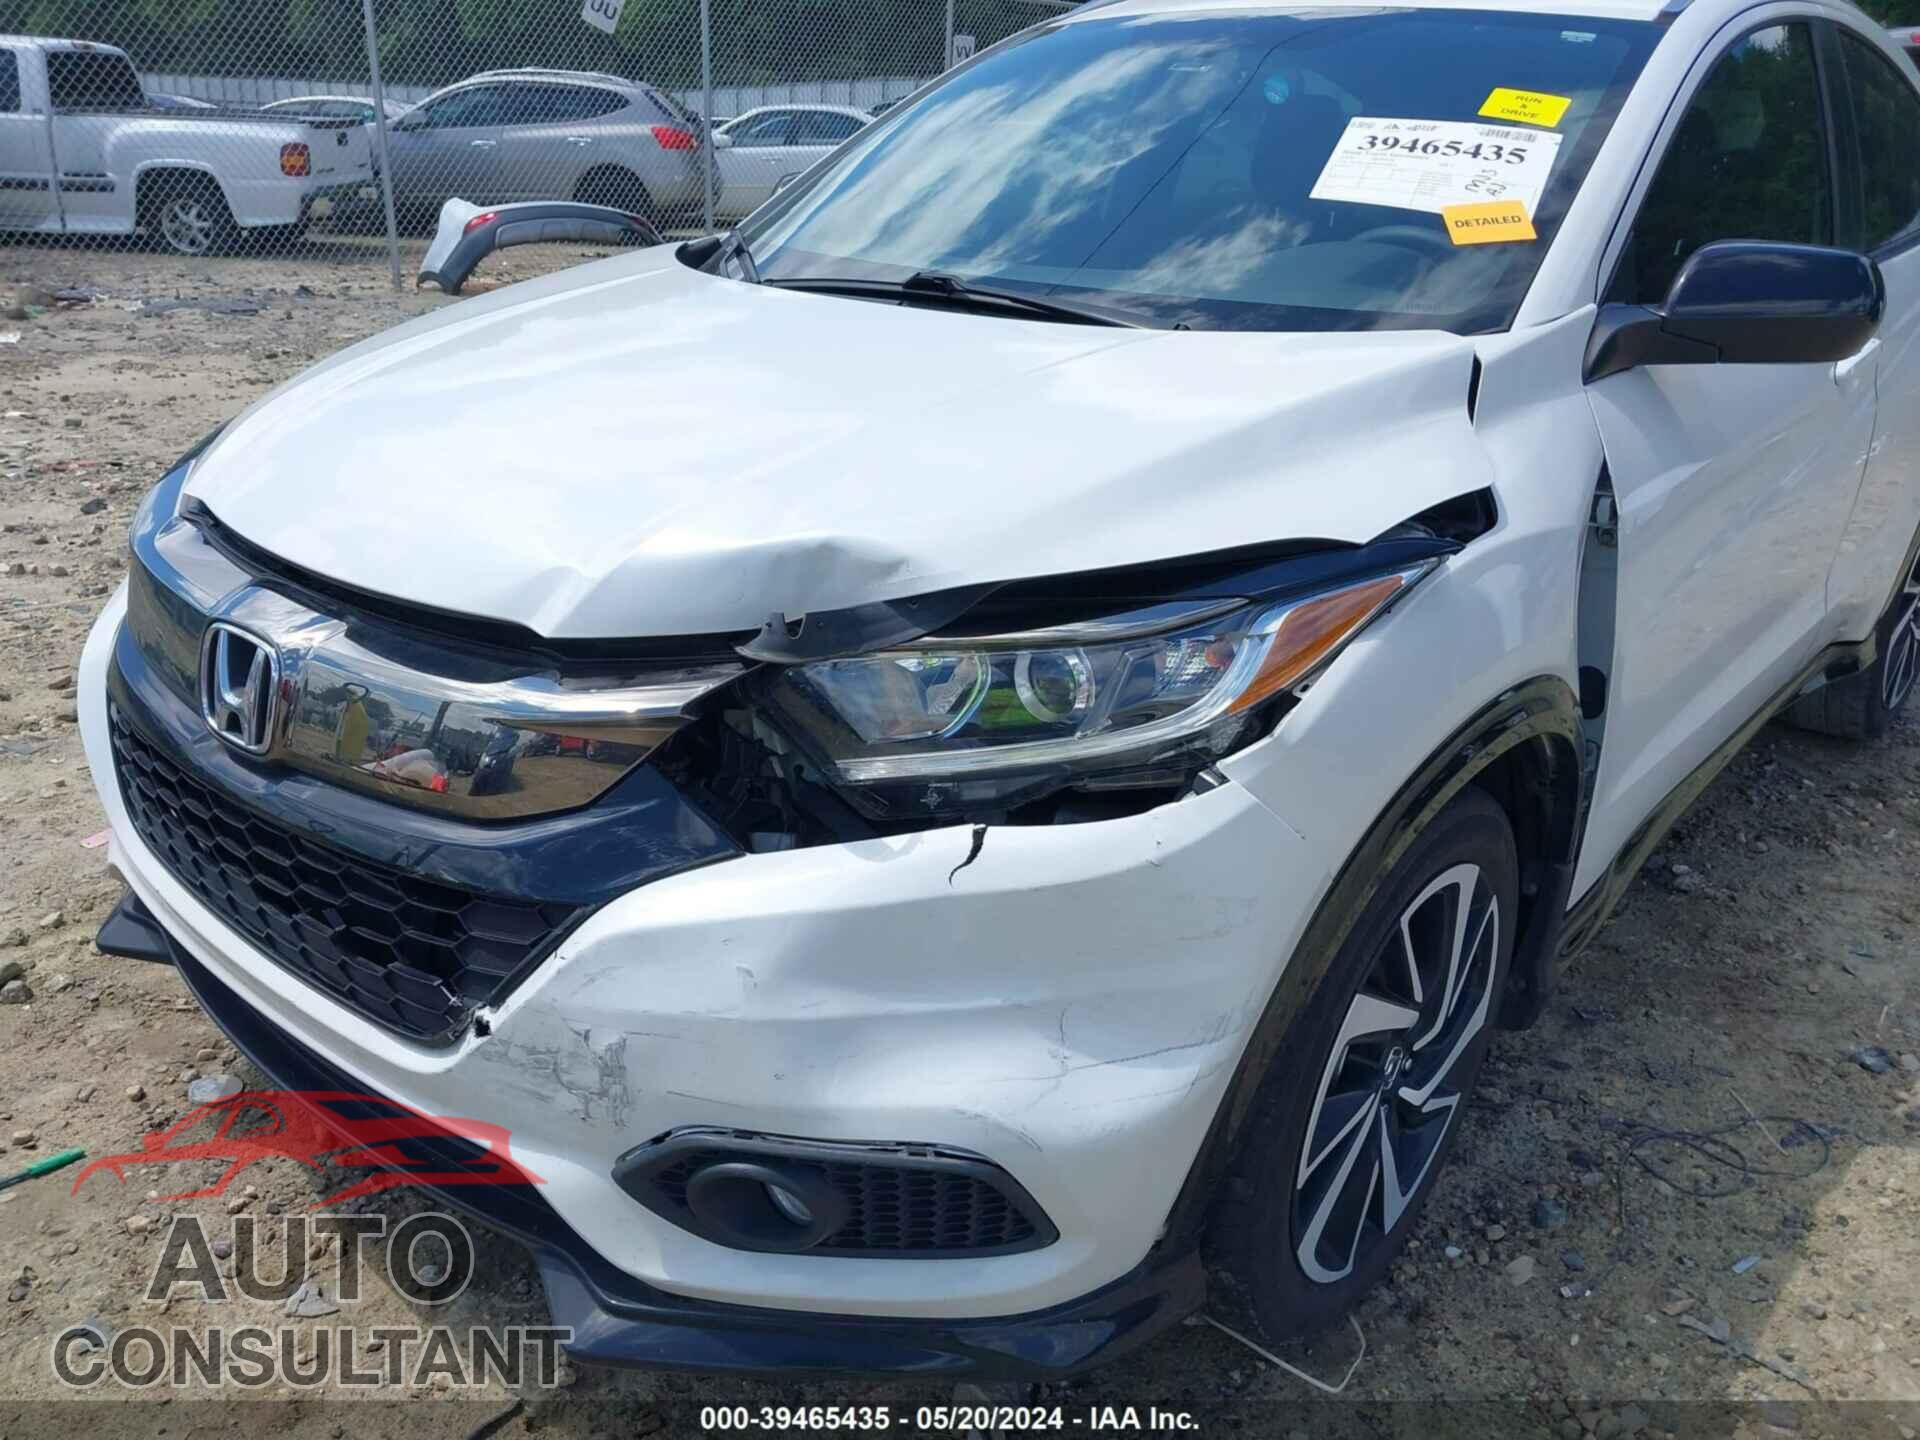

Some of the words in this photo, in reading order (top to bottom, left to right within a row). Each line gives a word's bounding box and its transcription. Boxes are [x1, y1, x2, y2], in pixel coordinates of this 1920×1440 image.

[1515, 95, 1542, 104] RUN
[1501, 108, 1540, 119] DRIVE
[1357, 135, 1528, 165] 39465435
[1455, 214, 1522, 229] DETAILED
